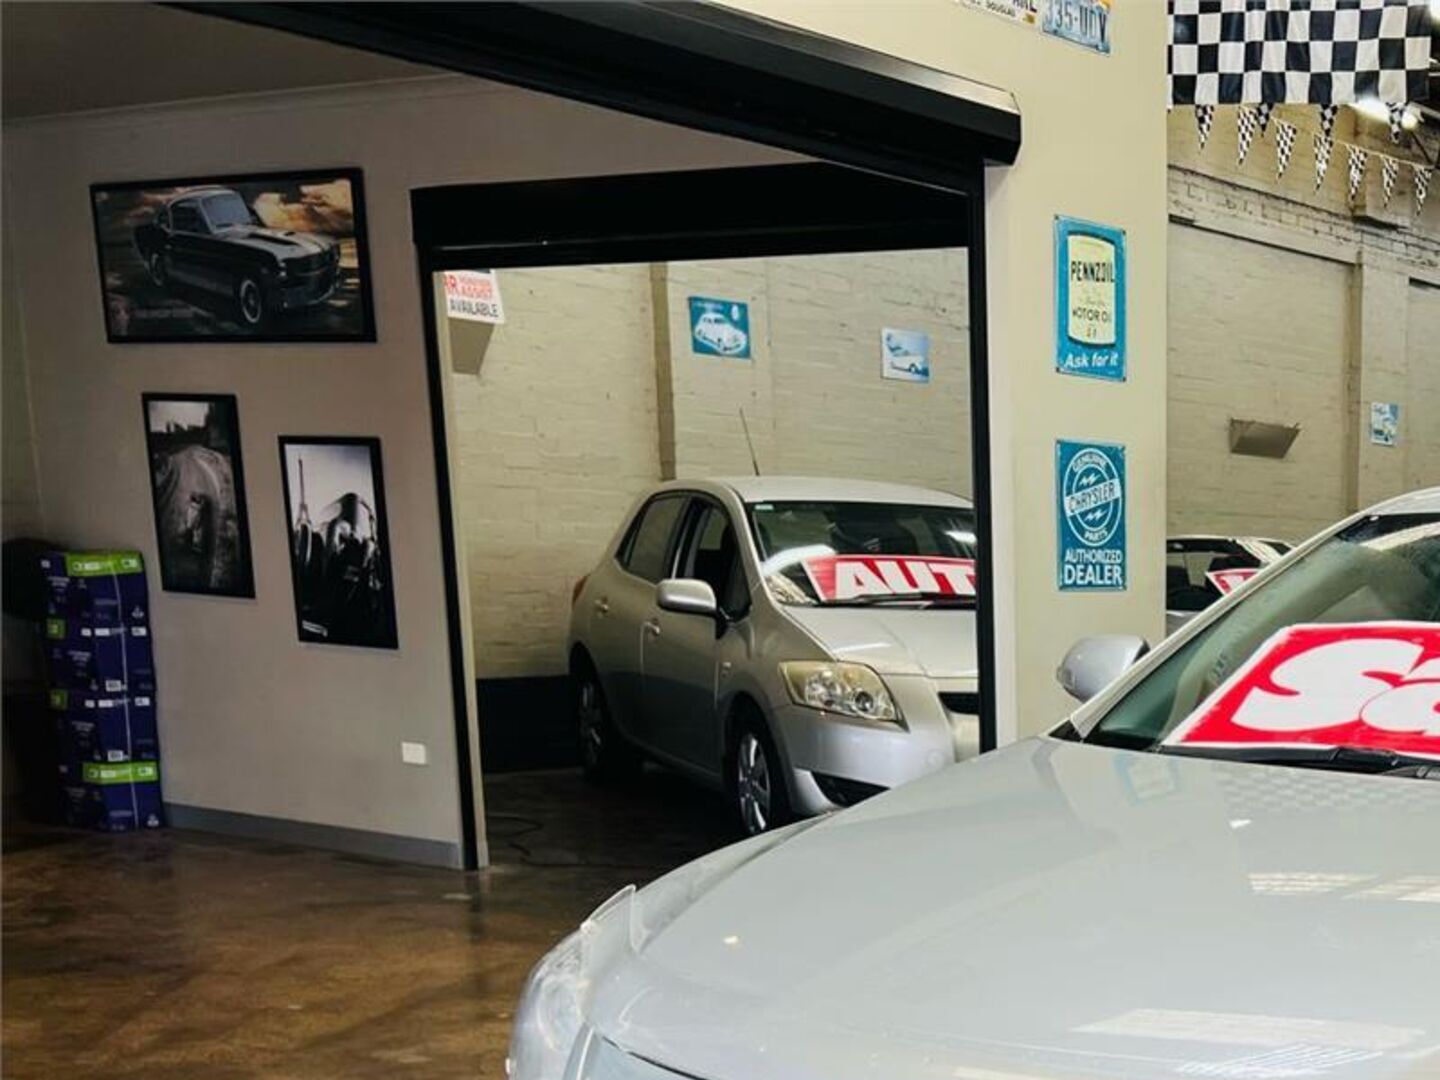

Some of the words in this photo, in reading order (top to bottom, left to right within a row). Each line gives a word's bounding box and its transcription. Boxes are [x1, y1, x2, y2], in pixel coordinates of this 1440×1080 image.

[1070, 260, 1116, 283] PENNZOIL
[1064, 352, 1090, 368] Ask
[1091, 350, 1109, 367] for
[1110, 350, 1119, 366] it
[1072, 453, 1107, 472] GENUINE
[1068, 482, 1116, 514] CHRYSLER
[1083, 529, 1109, 542] PARTS
[1064, 549, 1123, 564] AUTHORIZED
[1063, 564, 1124, 586] DEALER
